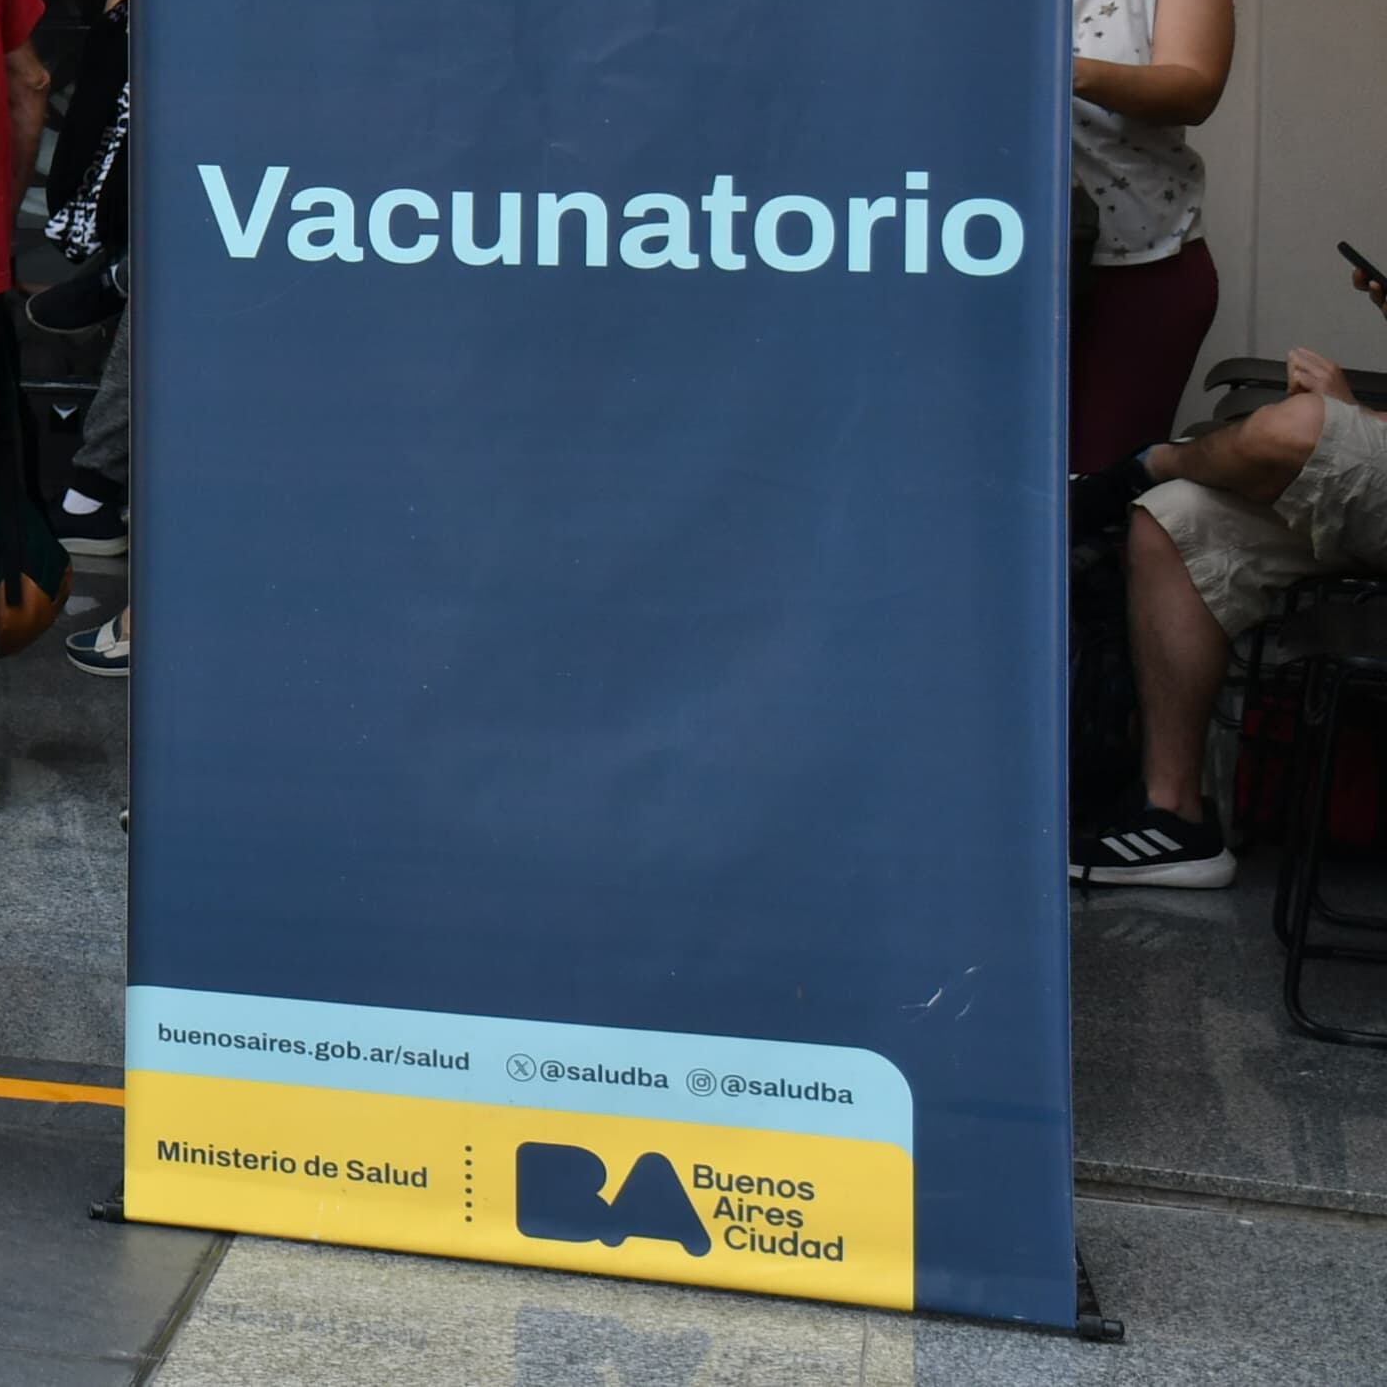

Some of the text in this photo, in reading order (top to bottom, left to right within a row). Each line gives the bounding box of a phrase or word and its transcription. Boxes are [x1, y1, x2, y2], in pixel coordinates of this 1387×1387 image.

[197, 164, 1024, 276] Vacunatorio
[158, 1023, 469, 1071] buenosaires.gob.ar/salud
[540, 1060, 669, 1089] @saludba
[720, 1074, 854, 1105] @saludba
[157, 1140, 427, 1188] Ministerio de Salud
[693, 1164, 815, 1201] Buenos
[515, 1141, 712, 1257] BA
[713, 1196, 804, 1229] Aires
[724, 1225, 844, 1262] Ciudad
